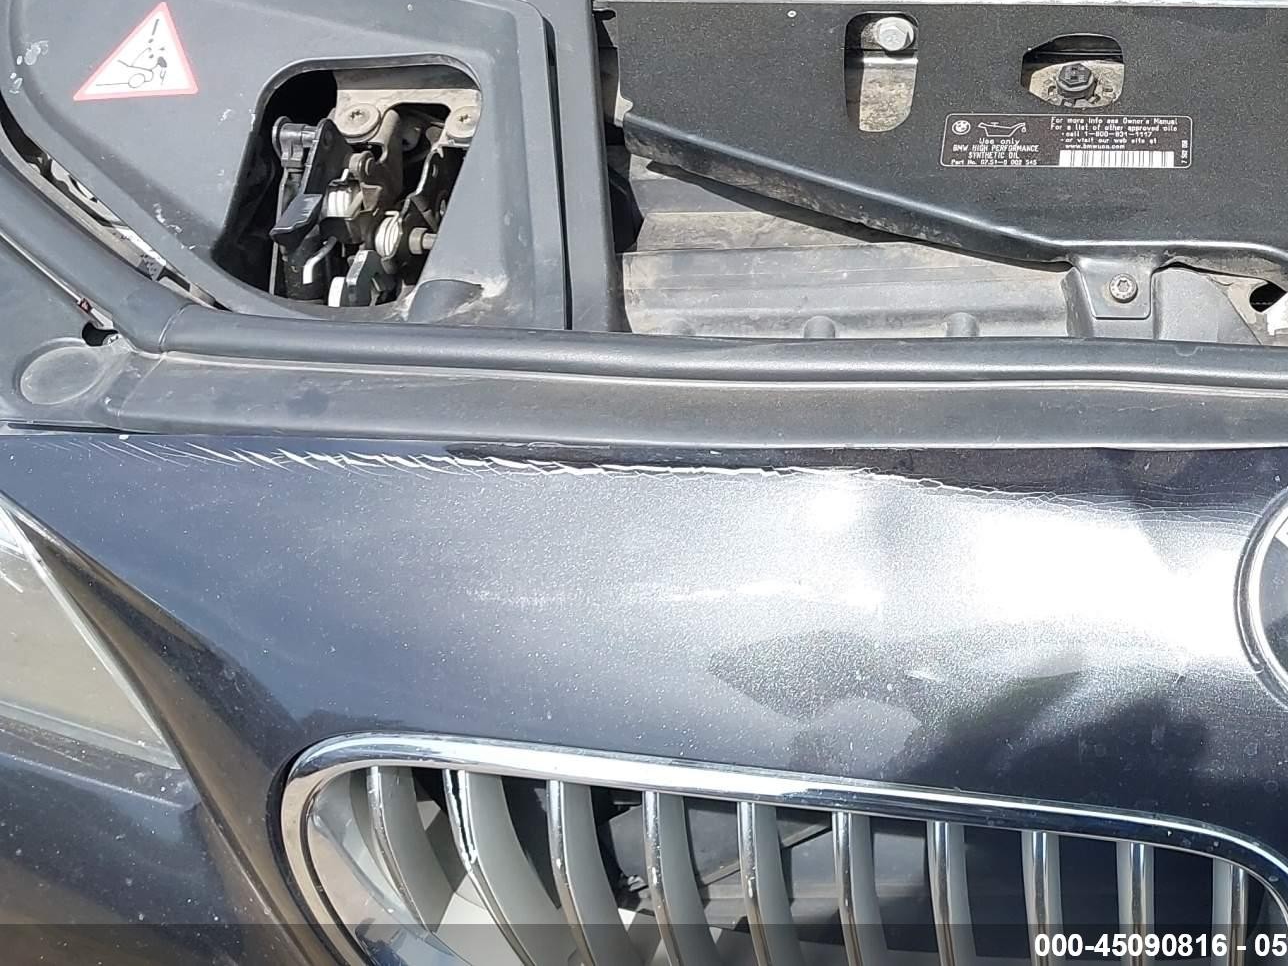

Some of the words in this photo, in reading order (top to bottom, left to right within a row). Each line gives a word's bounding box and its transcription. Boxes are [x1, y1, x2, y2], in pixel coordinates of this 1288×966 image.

[1122, 117, 1150, 125] Owner's
[1153, 117, 1178, 125] Manual
[1000, 138, 1020, 146] only
